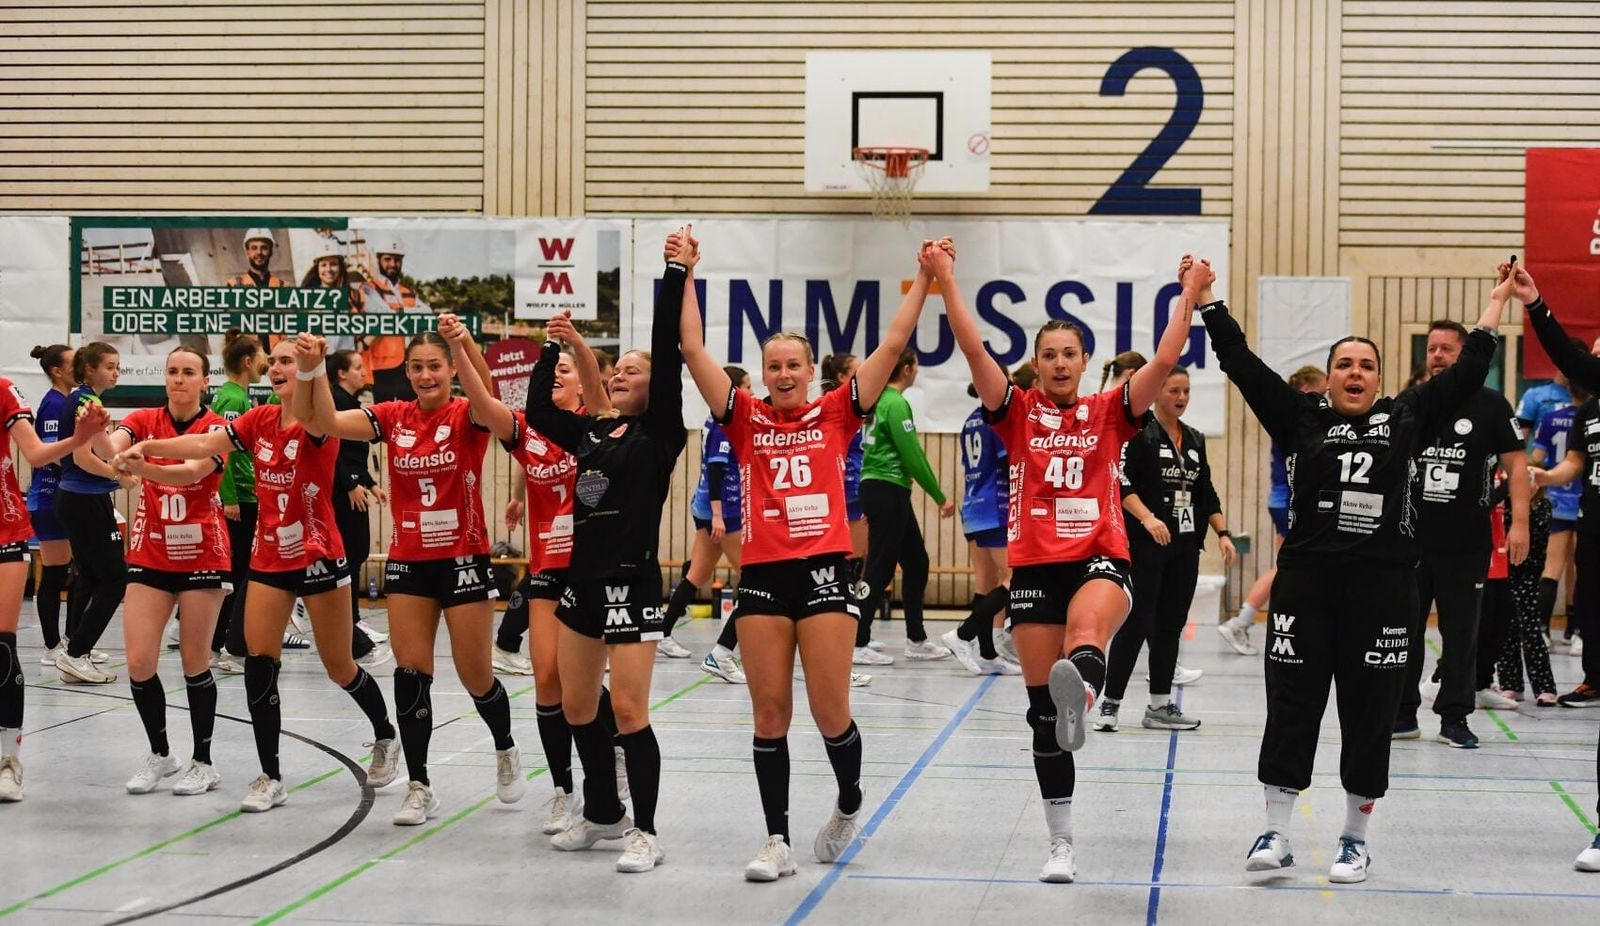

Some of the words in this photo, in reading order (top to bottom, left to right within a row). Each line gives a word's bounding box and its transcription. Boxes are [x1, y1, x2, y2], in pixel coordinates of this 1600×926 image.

[1087, 46, 1204, 214] 2
[538, 238, 575, 261] W
[538, 272, 574, 294] M
[112, 288, 153, 308] EIN
[162, 288, 342, 309] ARBEITSPLATZ?
[112, 313, 167, 333] ODER
[177, 313, 231, 333] EINE
[240, 314, 298, 334] NEUE
[308, 314, 477, 336] PERSPEKTI!
[497, 350, 525, 363] Jetzt
[117, 367, 134, 376] ehr
[753, 421, 823, 447] adensio
[1328, 423, 1391, 441] adesio
[394, 443, 456, 469] adensio
[1422, 443, 1466, 460] ensio
[770, 455, 812, 490] 26
[1044, 456, 1084, 489] 48
[1337, 452, 1373, 484] 12
[1430, 466, 1442, 482] C
[418, 477, 437, 507] 5
[159, 494, 187, 522] 10
[1181, 509, 1192, 524] A
[306, 560, 328, 577] M
[458, 568, 480, 587] M
[811, 566, 835, 585] W
[605, 586, 629, 602] W
[1011, 590, 1043, 600] KEIDEL
[606, 608, 632, 625] M
[1273, 613, 1295, 632] W
[1272, 637, 1295, 656] M
[1365, 651, 1408, 664] CAB
